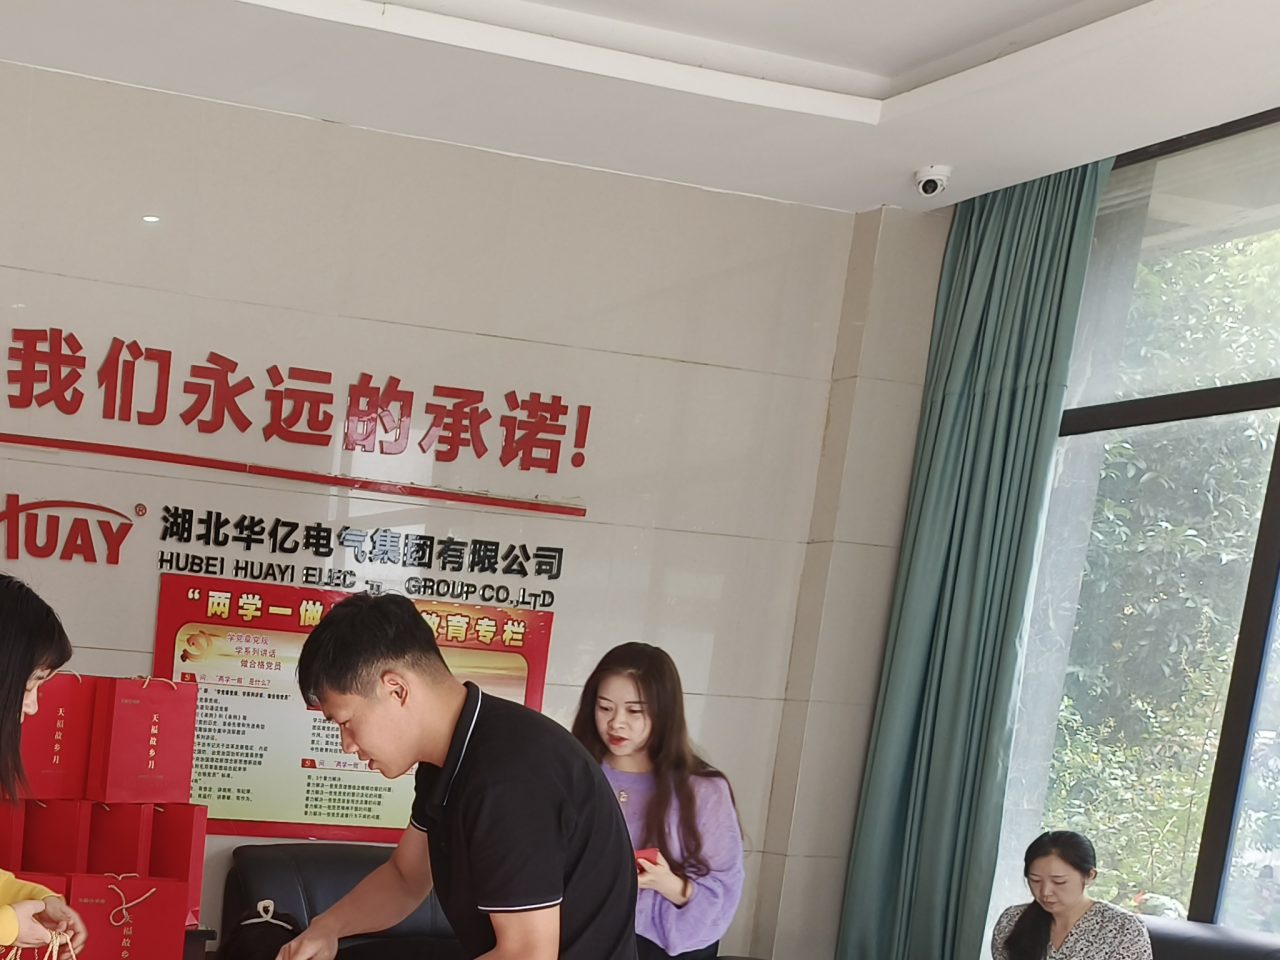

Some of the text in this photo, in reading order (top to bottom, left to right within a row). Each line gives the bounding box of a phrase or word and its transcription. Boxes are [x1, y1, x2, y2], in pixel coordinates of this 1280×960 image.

[160, 505, 563, 580] 湖北华亿电气集团有限公司
[158, 550, 224, 575] HUBEI
[232, 559, 294, 583] HUAYI
[405, 576, 477, 600] GROUP
[187, 589, 336, 627] “两学一做
[52, 708, 65, 764] 天福故乡月
[147, 713, 161, 769] 天福故乡月
